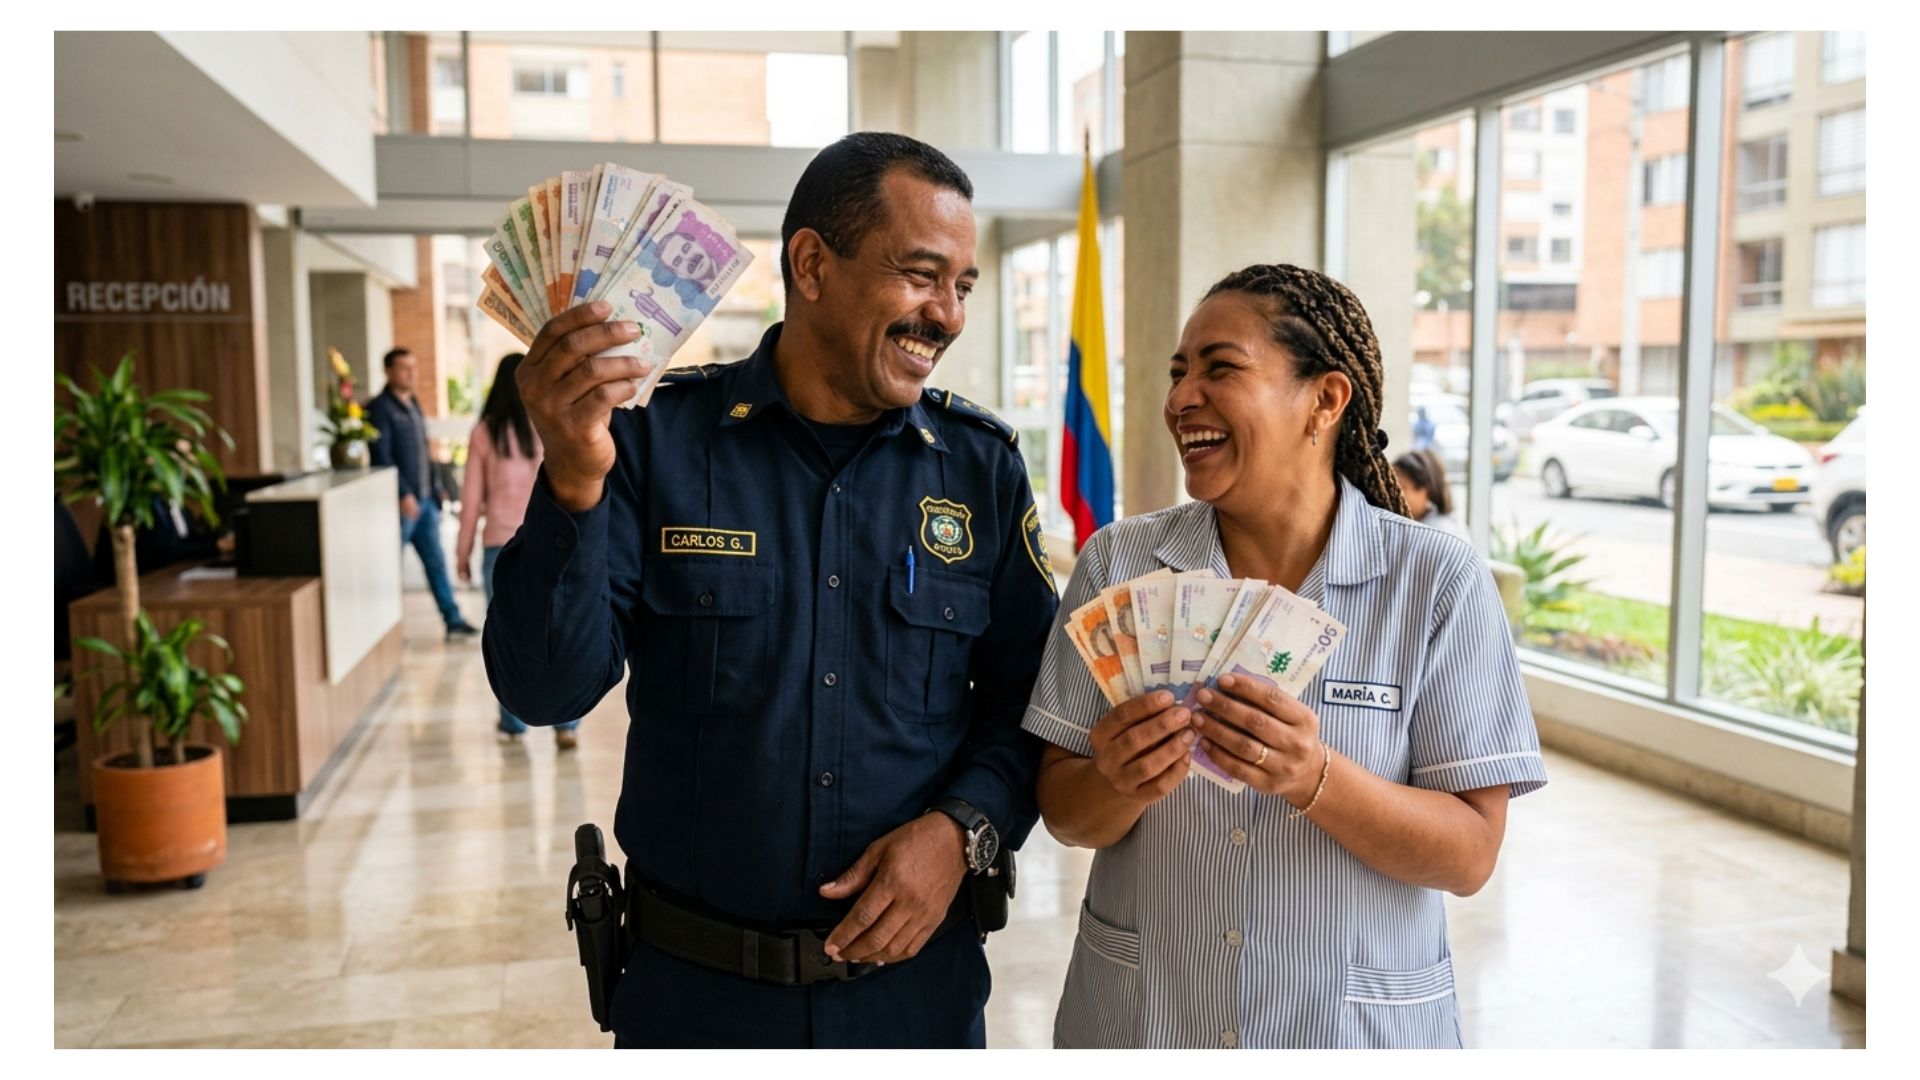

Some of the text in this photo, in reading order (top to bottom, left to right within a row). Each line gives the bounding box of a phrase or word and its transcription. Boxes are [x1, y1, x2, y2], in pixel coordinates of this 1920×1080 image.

[66, 275, 231, 312] RECEPCIÓN
[671, 534, 744, 550] CARLOS G.
[1332, 686, 1391, 704] MARÍA C.
